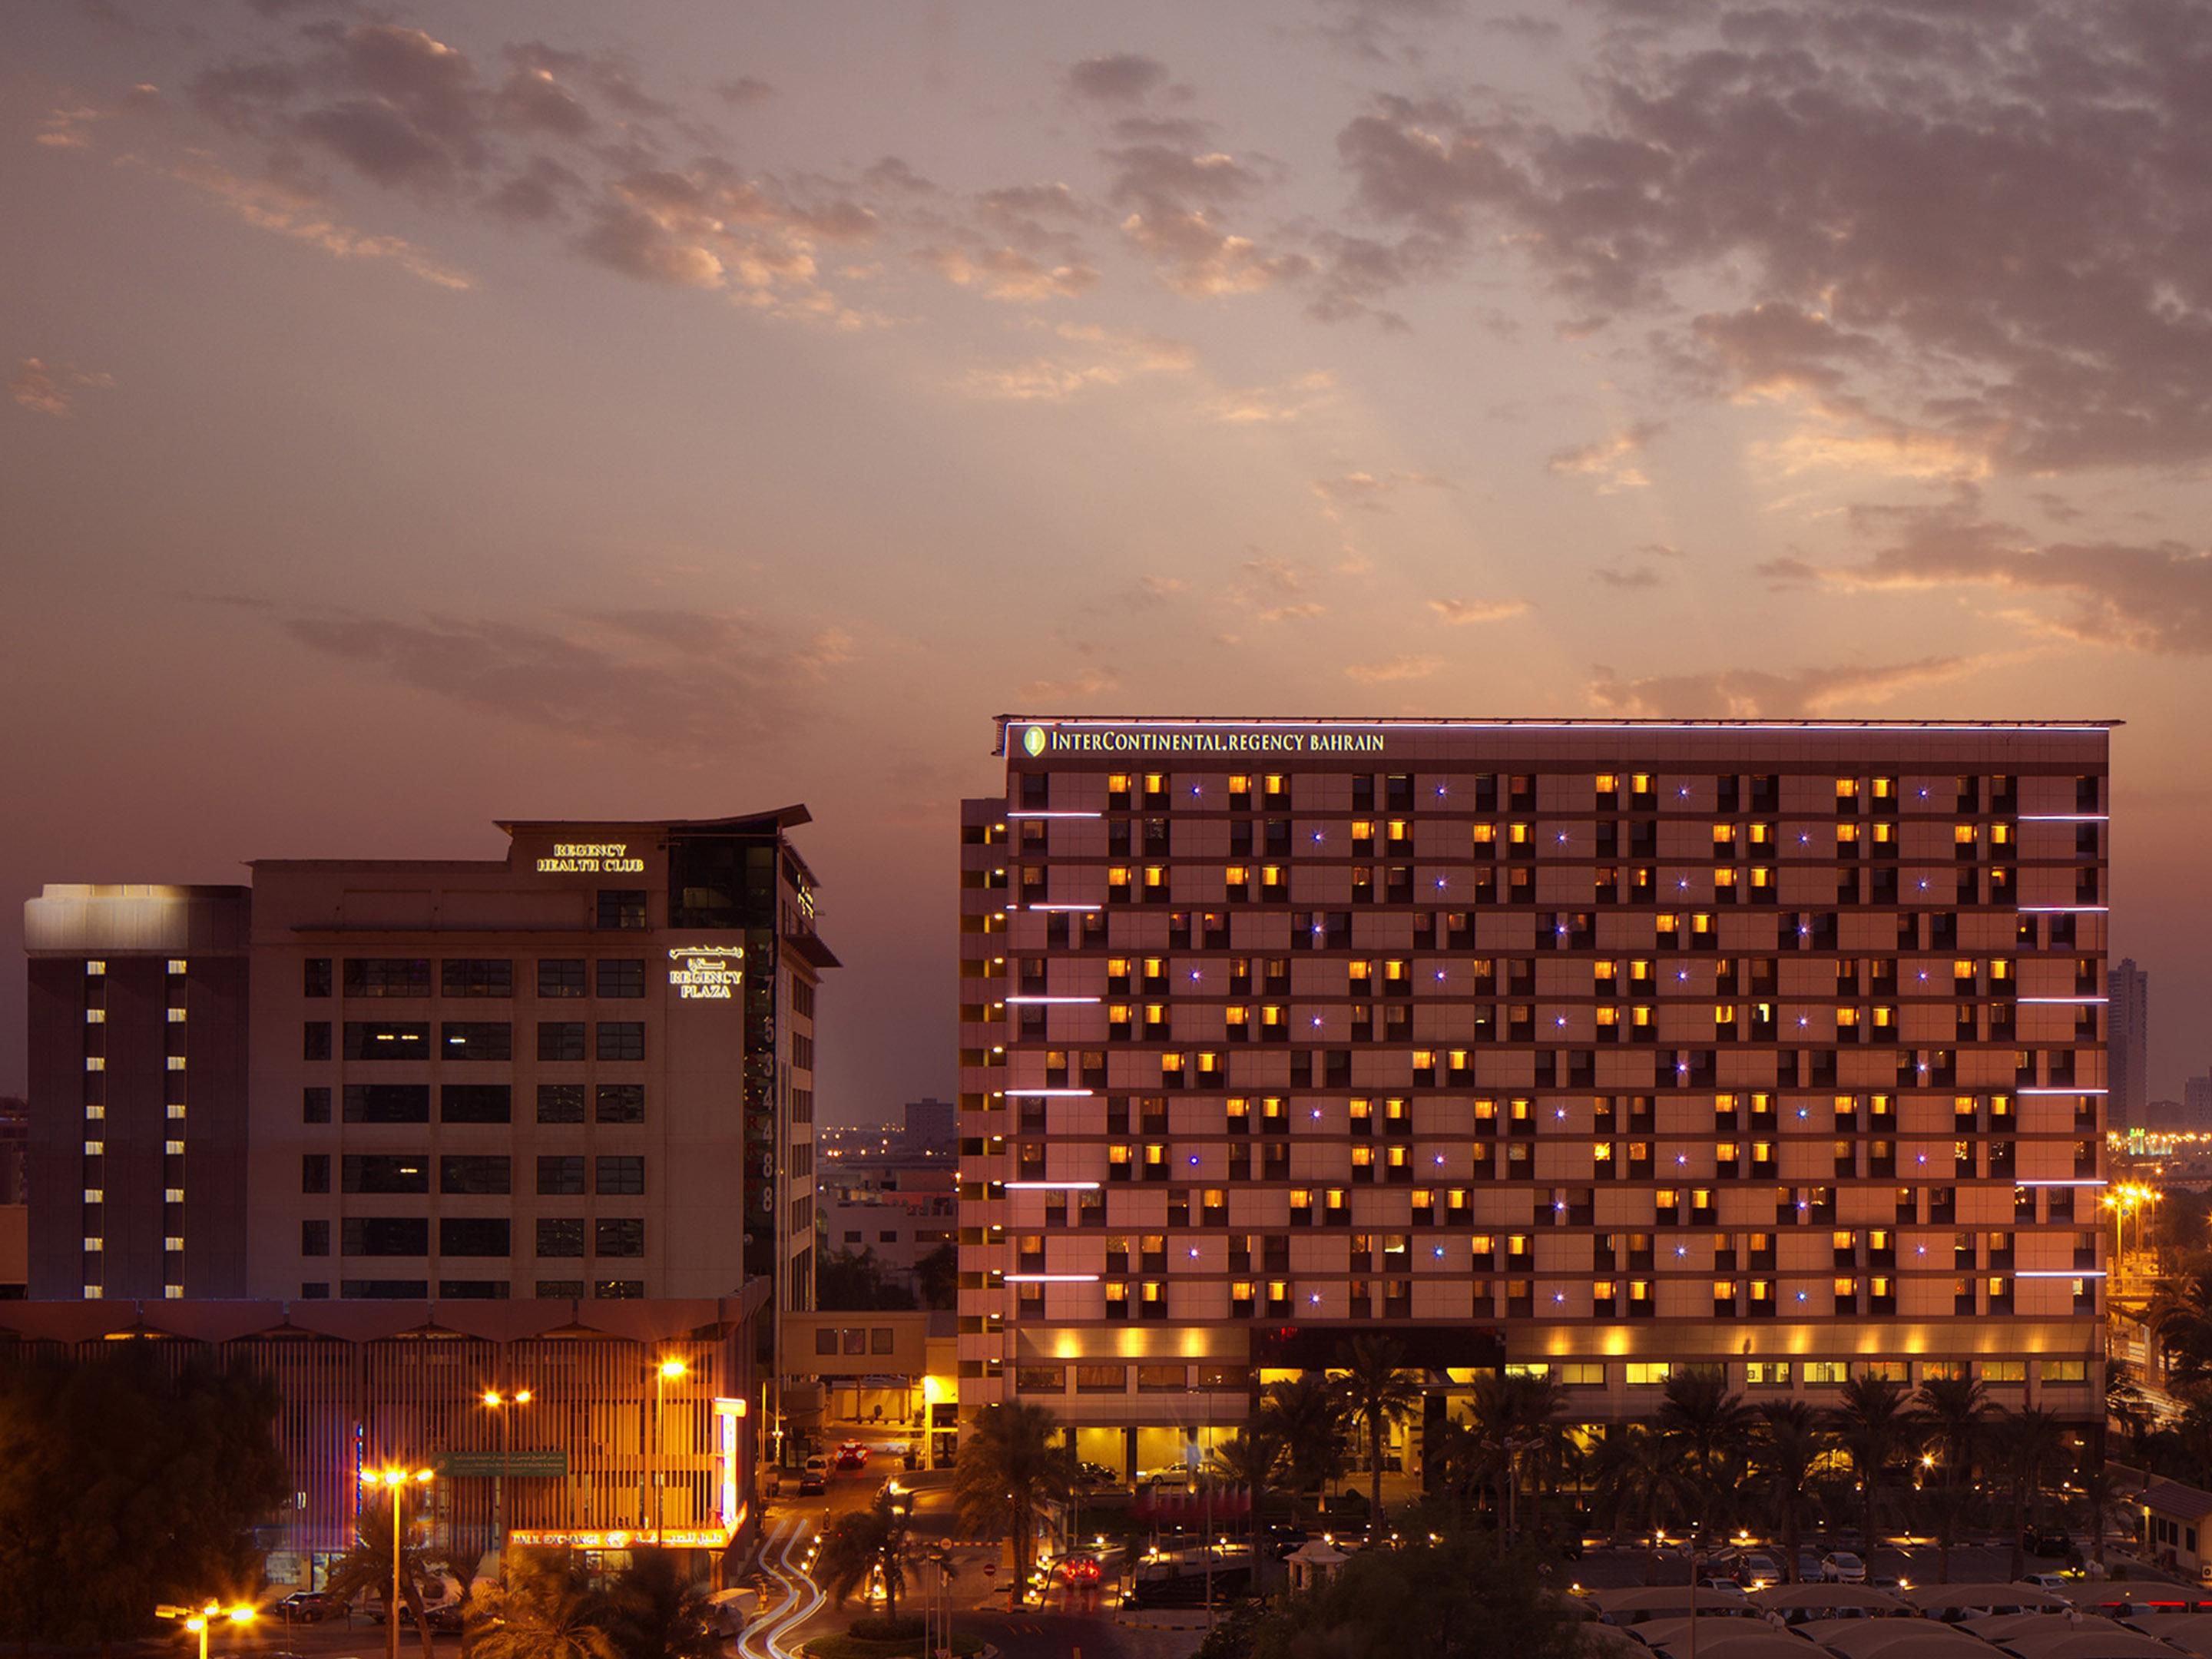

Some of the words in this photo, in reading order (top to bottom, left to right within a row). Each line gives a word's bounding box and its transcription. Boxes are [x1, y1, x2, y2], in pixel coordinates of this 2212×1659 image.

[1310, 733, 1384, 750] BAHRAIN
[554, 843, 627, 856] REGENCY
[536, 859, 599, 872] HEALTH
[602, 859, 644, 872] CLUB
[668, 971, 743, 985] REGENCY
[680, 985, 731, 998] PLAZA
